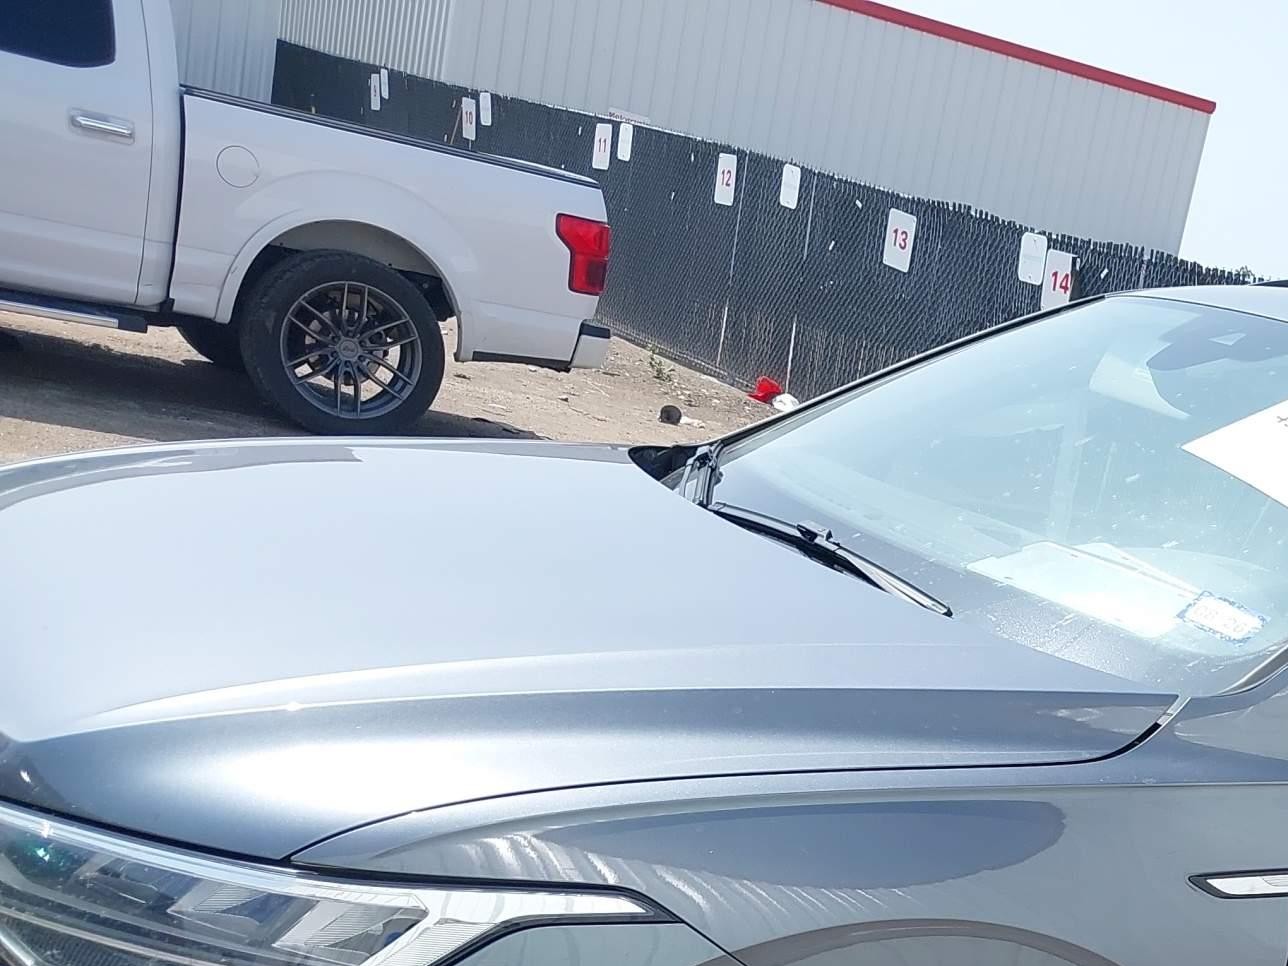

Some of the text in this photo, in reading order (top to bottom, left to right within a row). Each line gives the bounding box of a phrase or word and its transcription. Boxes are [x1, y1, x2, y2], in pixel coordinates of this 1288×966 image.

[465, 111, 473, 125] 10
[598, 137, 607, 153] 11
[721, 169, 732, 187] 12
[892, 227, 909, 251] 13
[1051, 271, 1070, 295] 14
